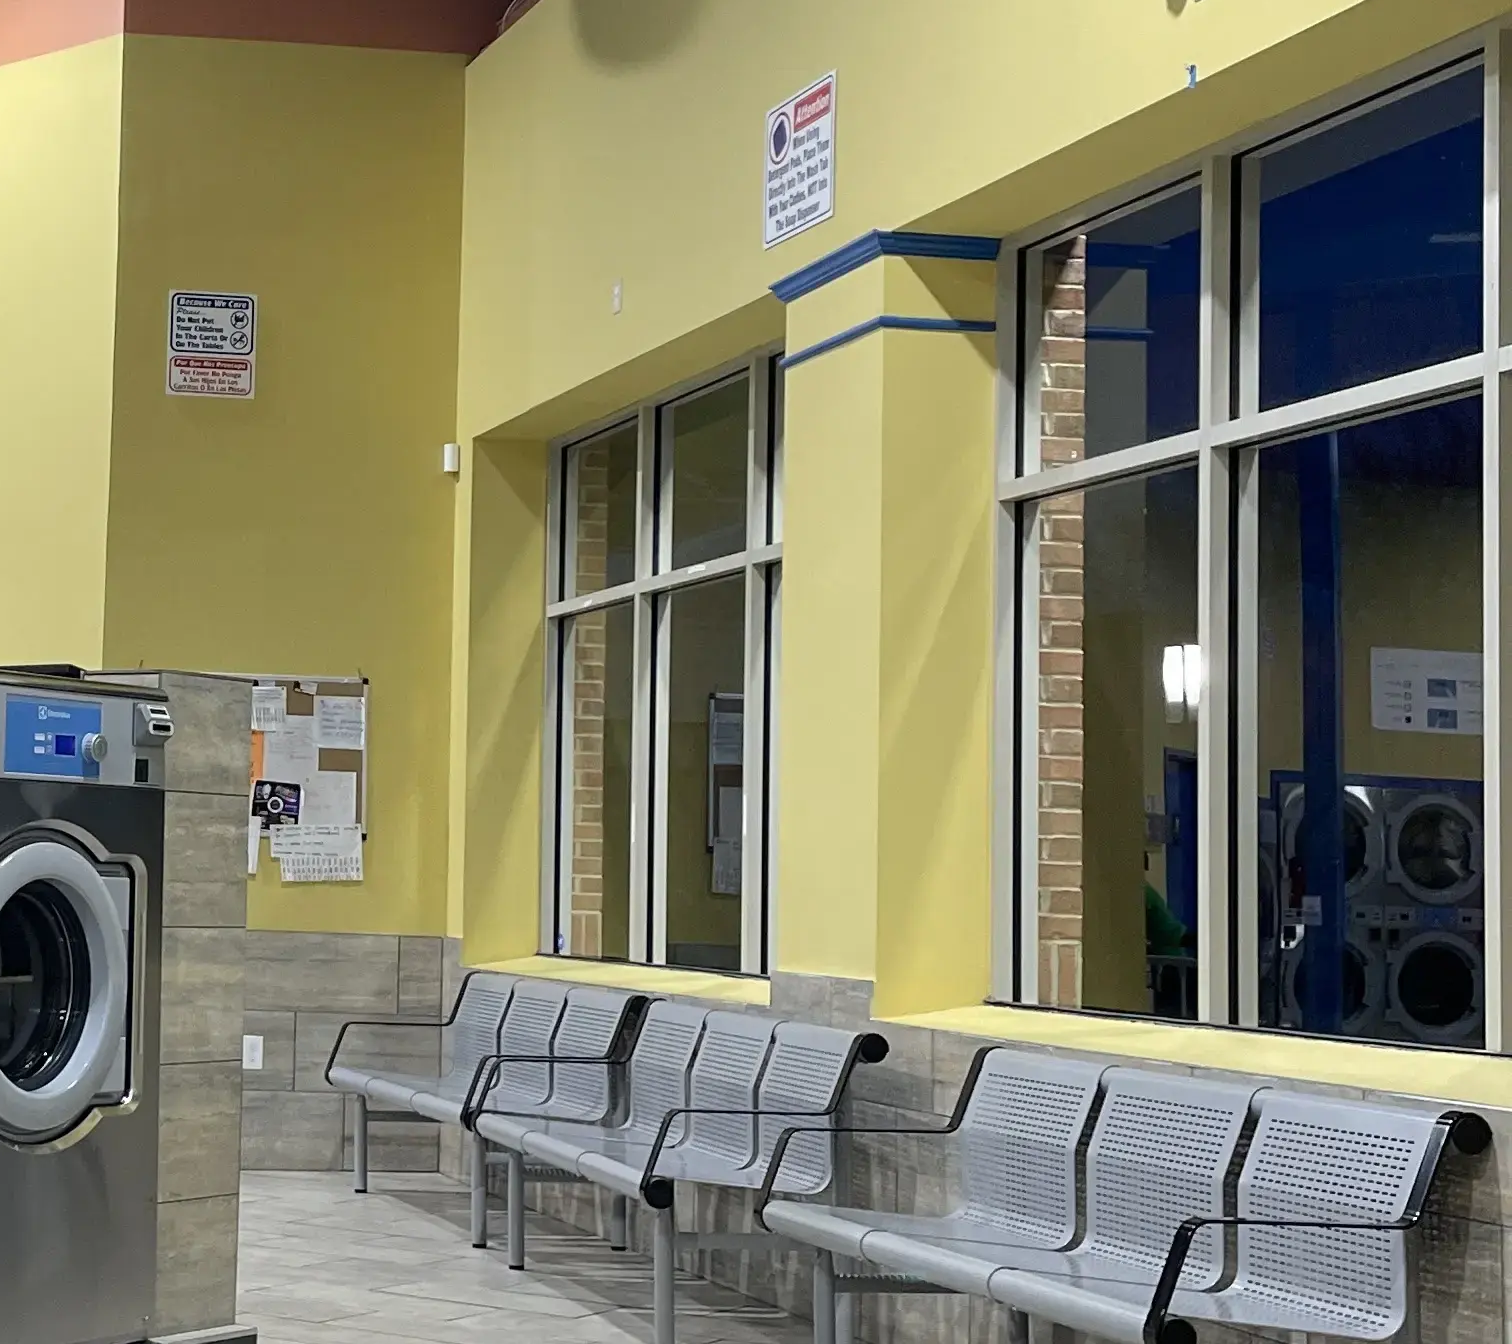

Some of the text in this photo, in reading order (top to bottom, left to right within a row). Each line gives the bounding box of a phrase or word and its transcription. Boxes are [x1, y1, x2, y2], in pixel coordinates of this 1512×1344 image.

[795, 93, 830, 124] Attention
[180, 298, 212, 307] Because
[228, 301, 247, 309] Care
